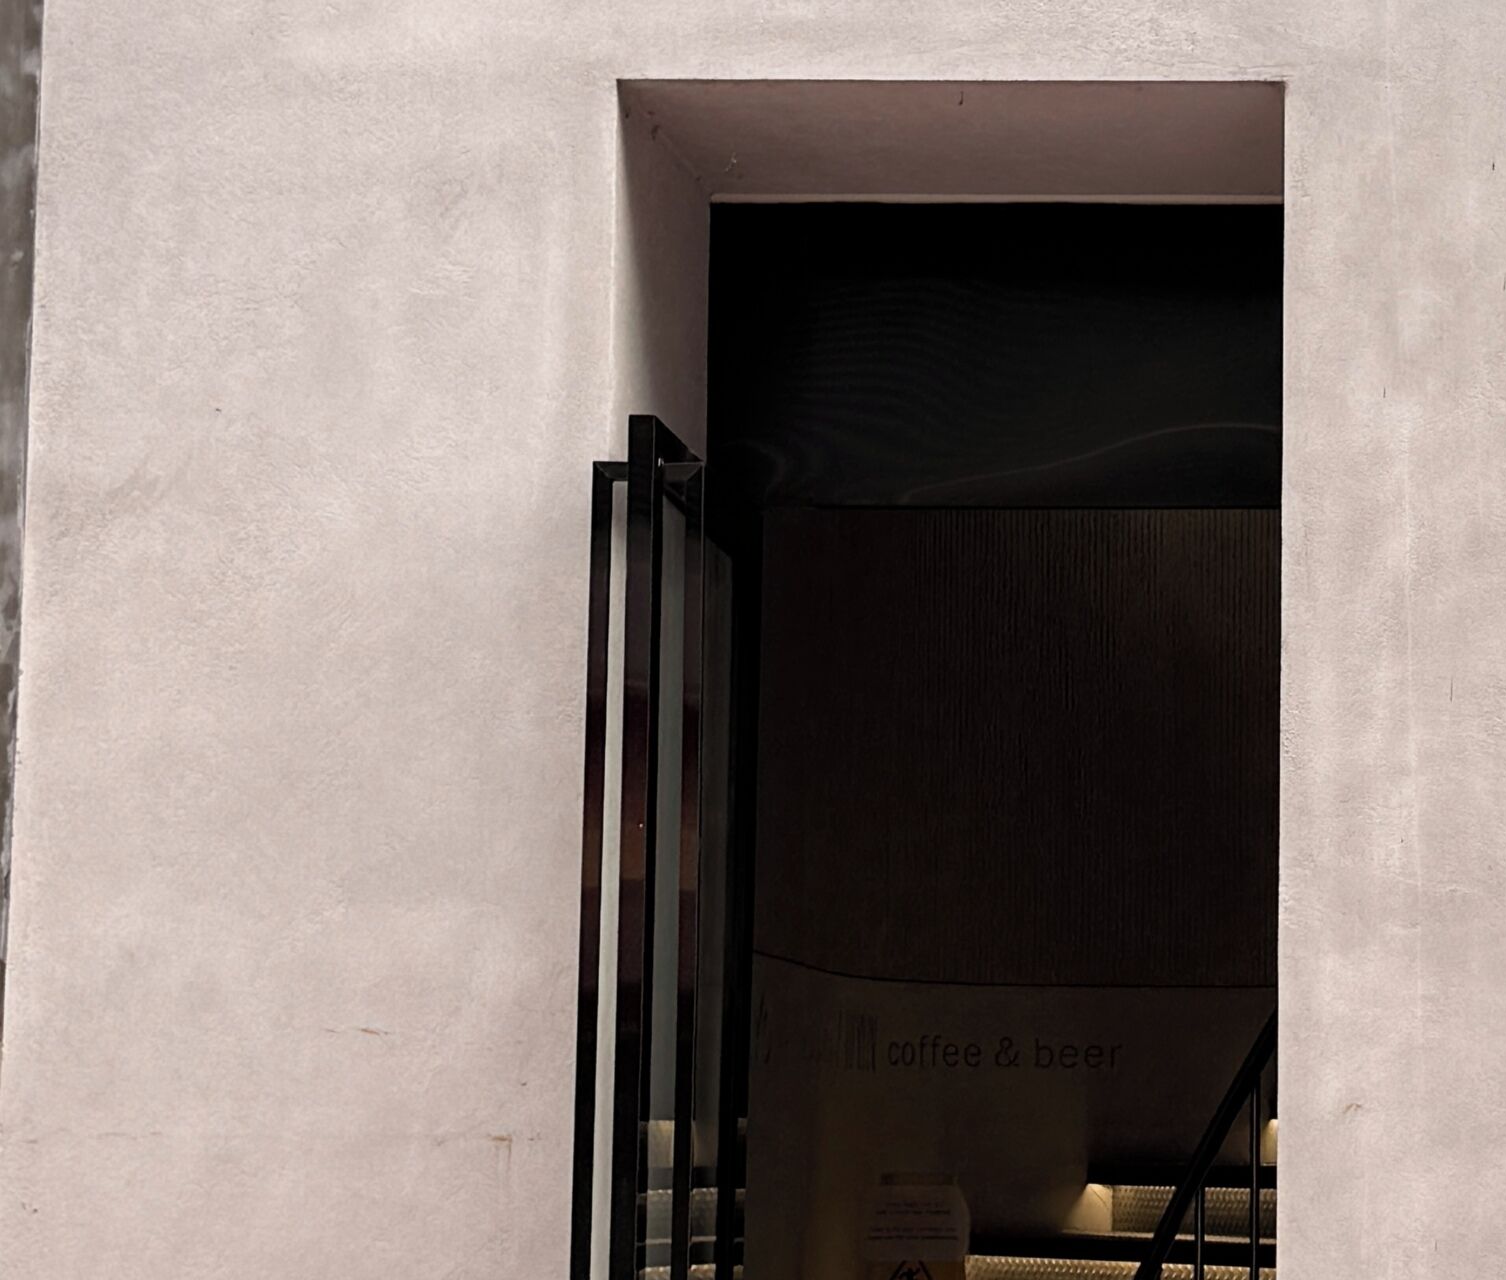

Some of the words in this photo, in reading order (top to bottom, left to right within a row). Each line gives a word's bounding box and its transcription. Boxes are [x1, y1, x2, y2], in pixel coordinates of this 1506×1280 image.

[887, 1034, 982, 1068] coffee
[994, 1037, 1020, 1068] &
[1034, 1037, 1122, 1070] beer
